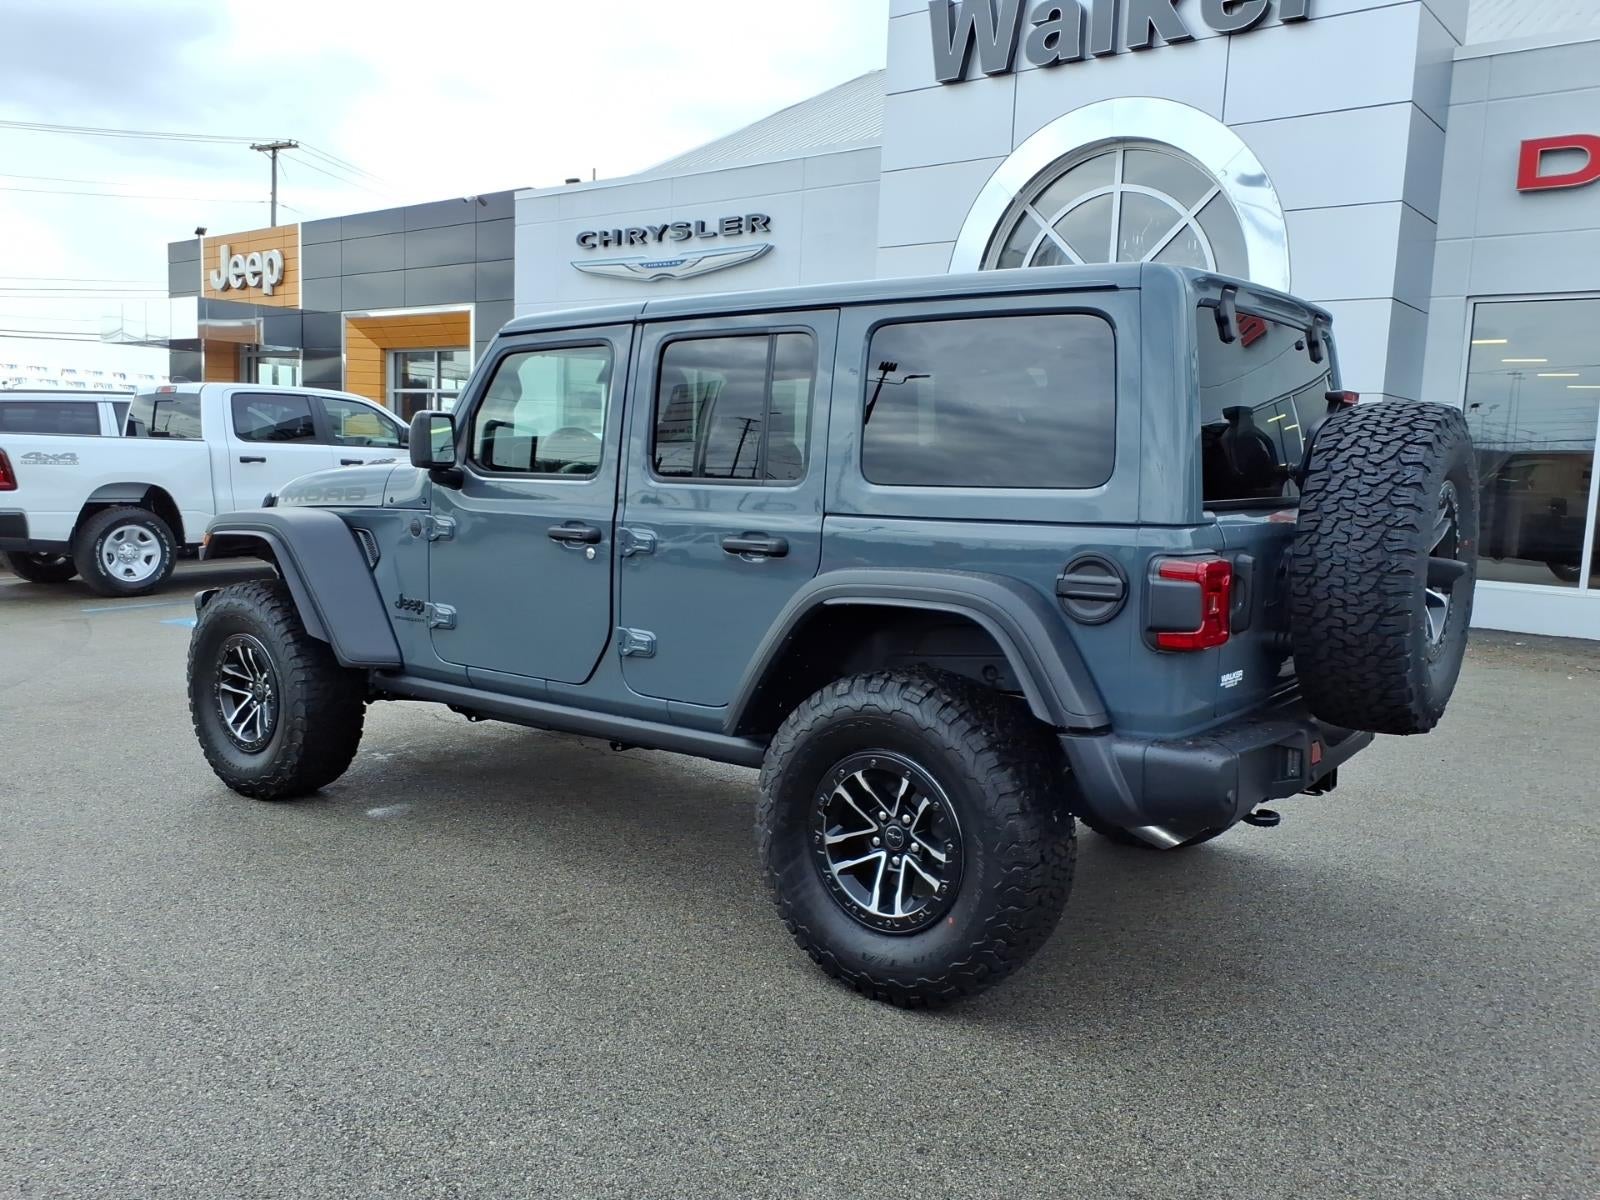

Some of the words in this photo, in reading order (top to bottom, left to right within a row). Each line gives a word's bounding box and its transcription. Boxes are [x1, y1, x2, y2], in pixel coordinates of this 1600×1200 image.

[576, 213, 771, 250] CHRYSLER
[209, 243, 285, 296] Jeep
[395, 593, 425, 615] Jeep
